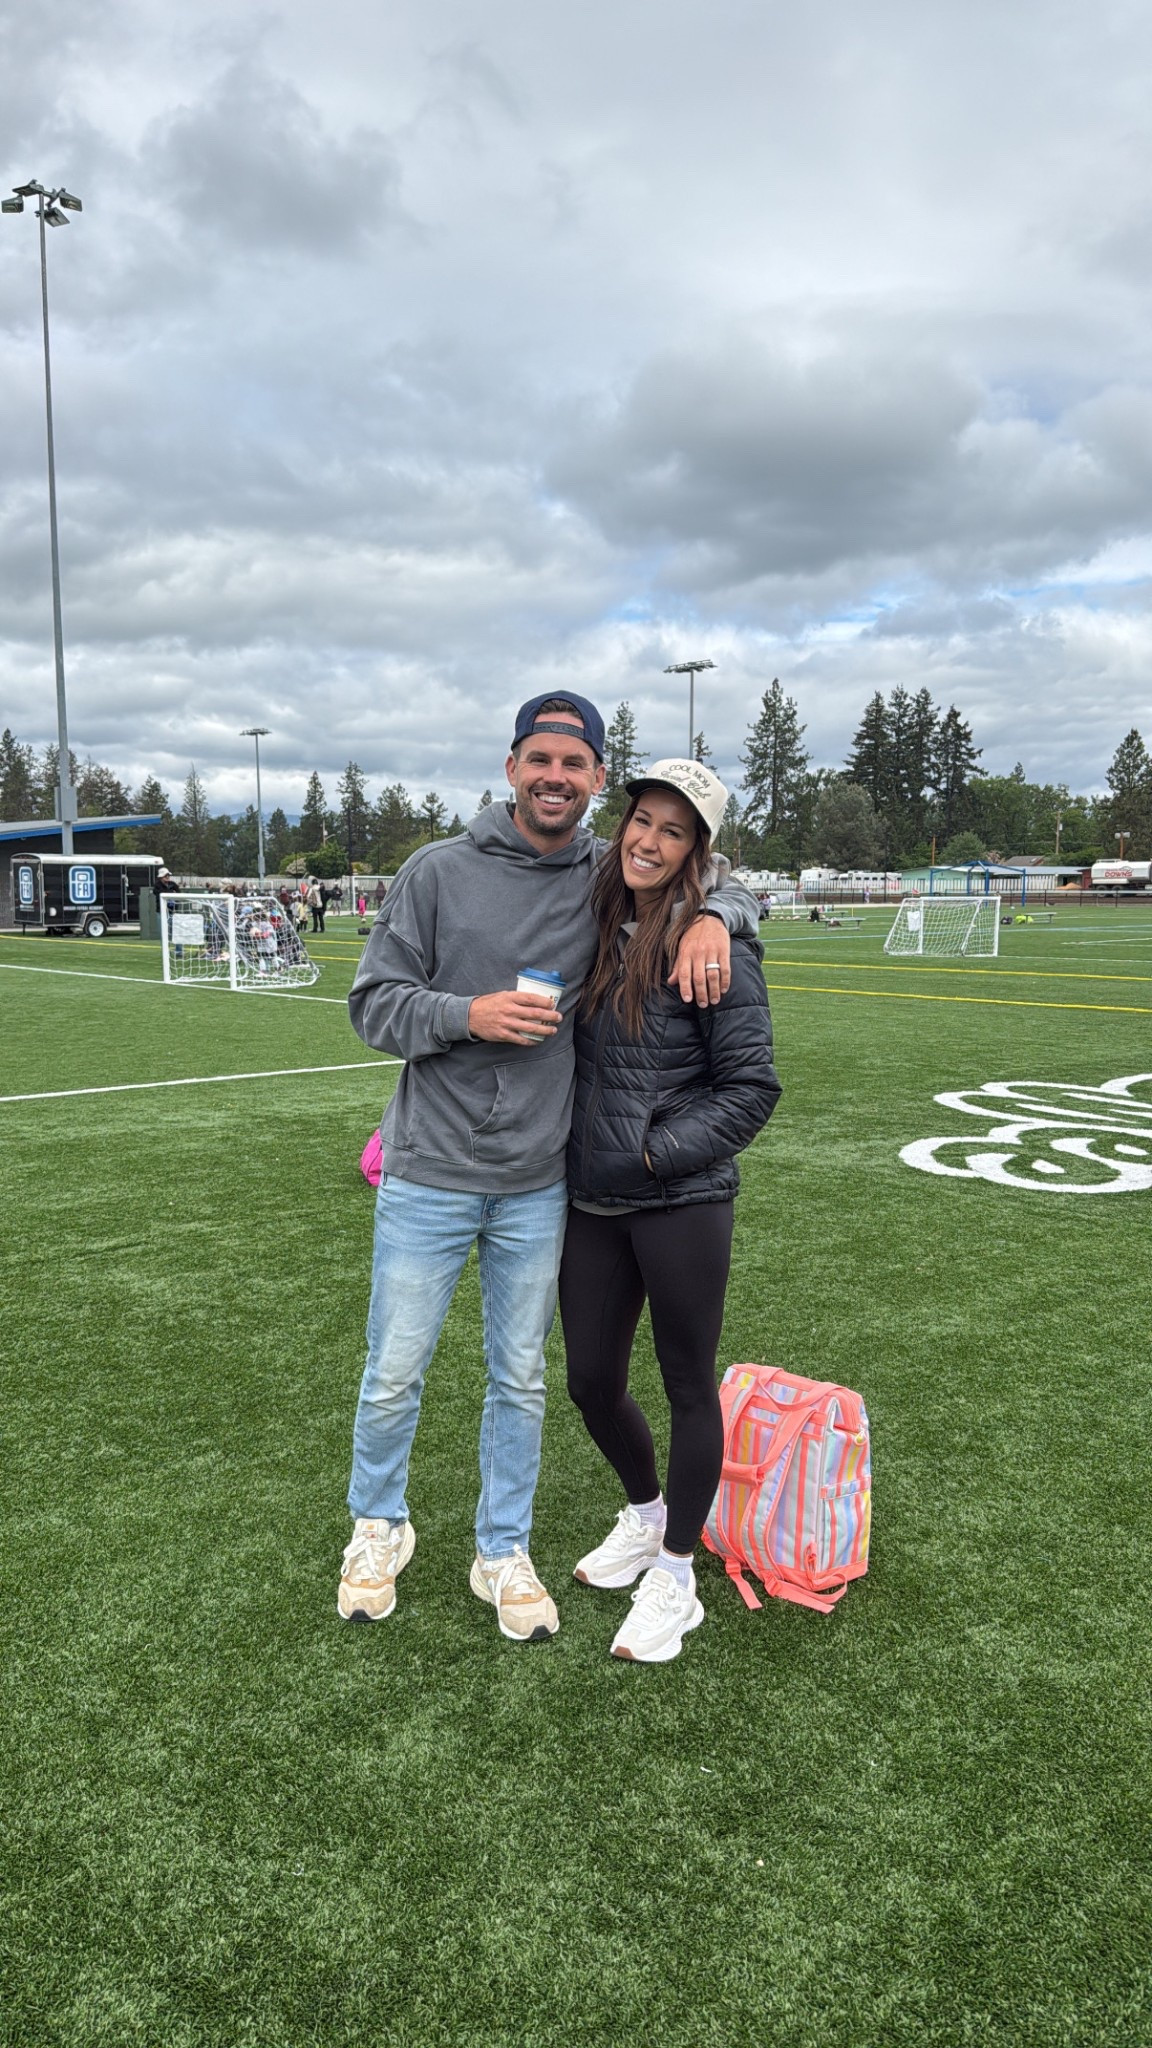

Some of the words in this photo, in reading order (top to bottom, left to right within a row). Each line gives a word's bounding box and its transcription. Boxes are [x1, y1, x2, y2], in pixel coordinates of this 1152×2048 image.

[669, 764, 692, 774] COOL
[692, 770, 711, 789] MOM
[687, 780, 711, 800] Club
